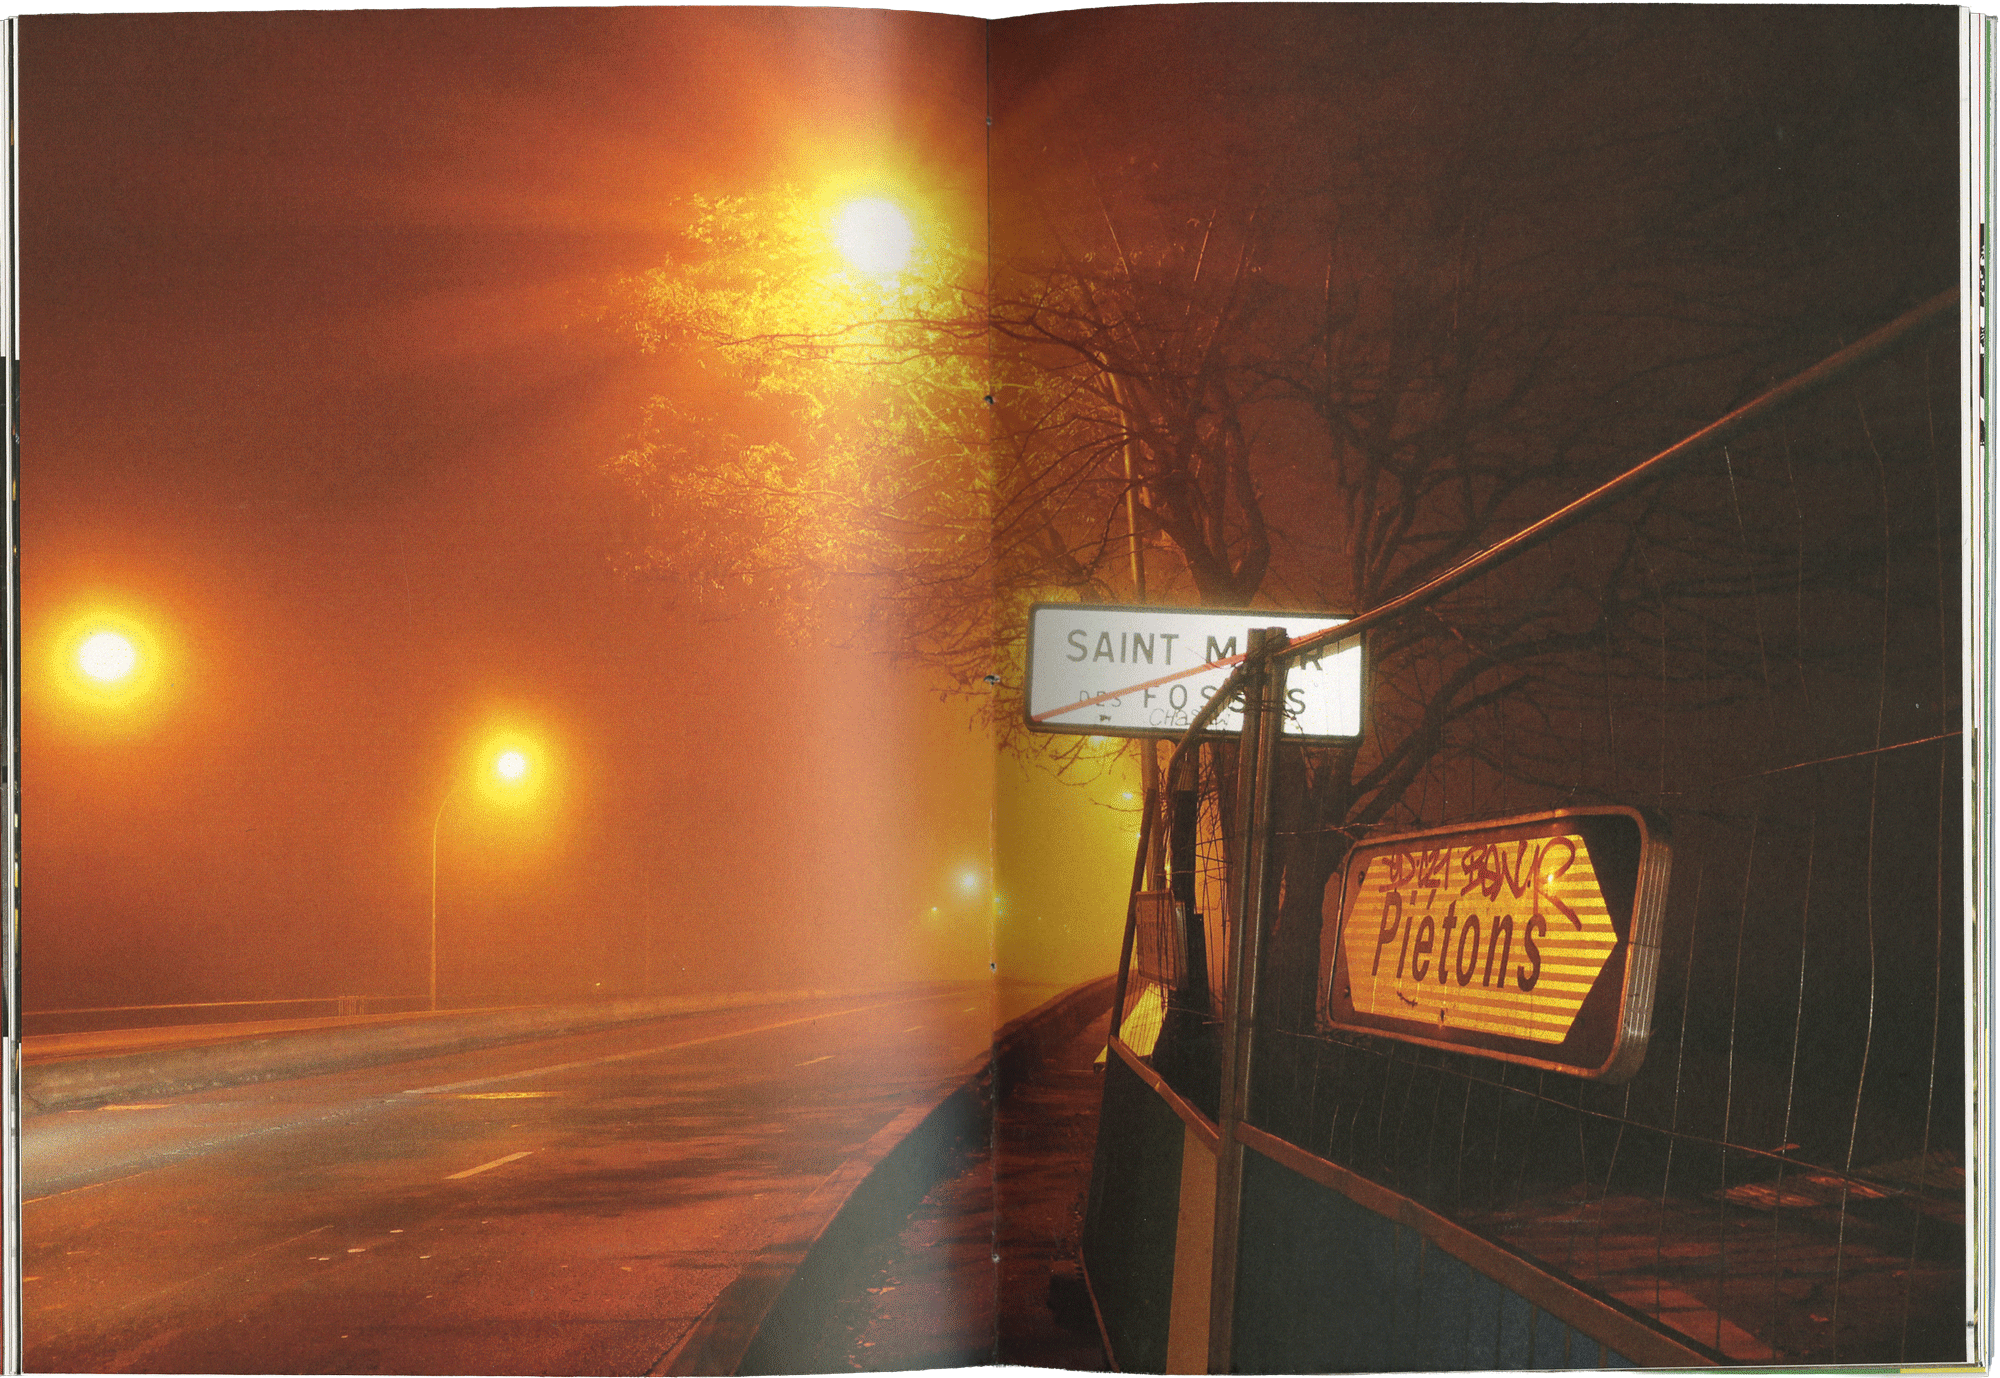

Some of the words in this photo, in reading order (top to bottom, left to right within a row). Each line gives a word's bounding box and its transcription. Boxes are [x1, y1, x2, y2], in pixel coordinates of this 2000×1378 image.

[1065, 629, 1180, 666] SAINT
[1205, 635, 1323, 671] MR
[1371, 889, 1547, 993] Piétons
